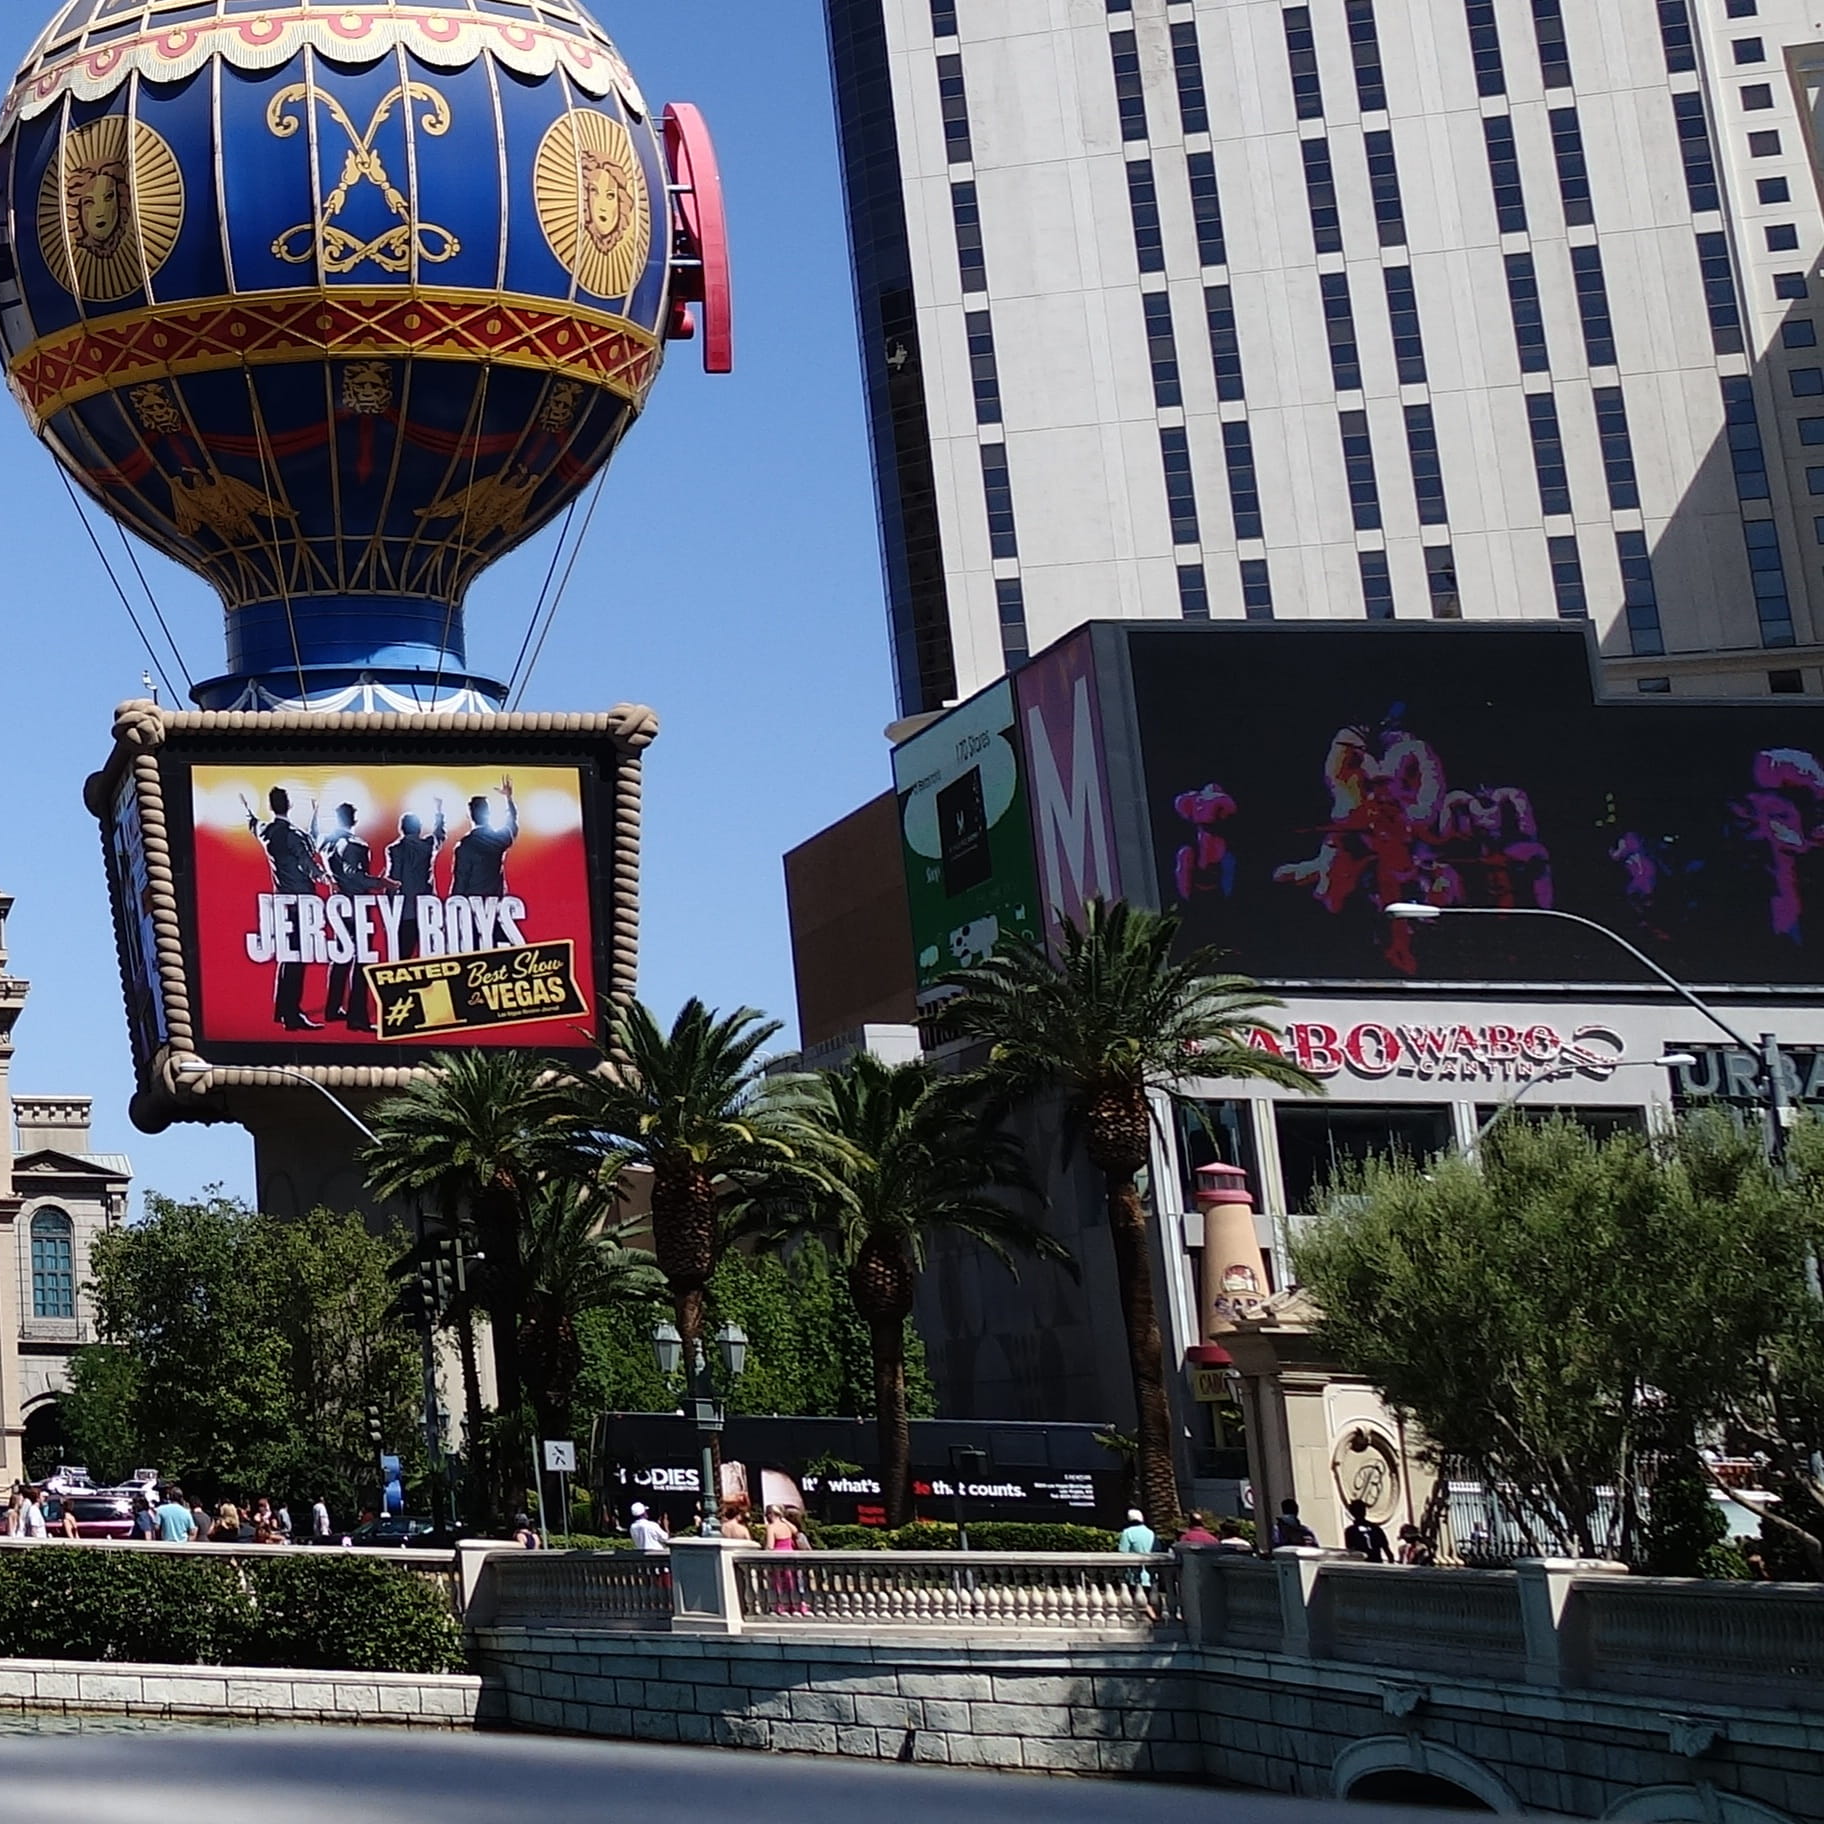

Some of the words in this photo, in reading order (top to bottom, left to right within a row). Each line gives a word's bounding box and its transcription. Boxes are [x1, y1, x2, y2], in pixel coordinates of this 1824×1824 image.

[245, 893, 406, 964] JERSEY
[415, 894, 527, 957] BOYS
[374, 961, 461, 986] RATED
[466, 961, 509, 988] Best
[512, 950, 565, 979] Show
[481, 976, 567, 1011] VEGAS
[1402, 1024, 1561, 1063] WABO
[828, 1478, 881, 1494] what's
[968, 1481, 1027, 1498] counts.
